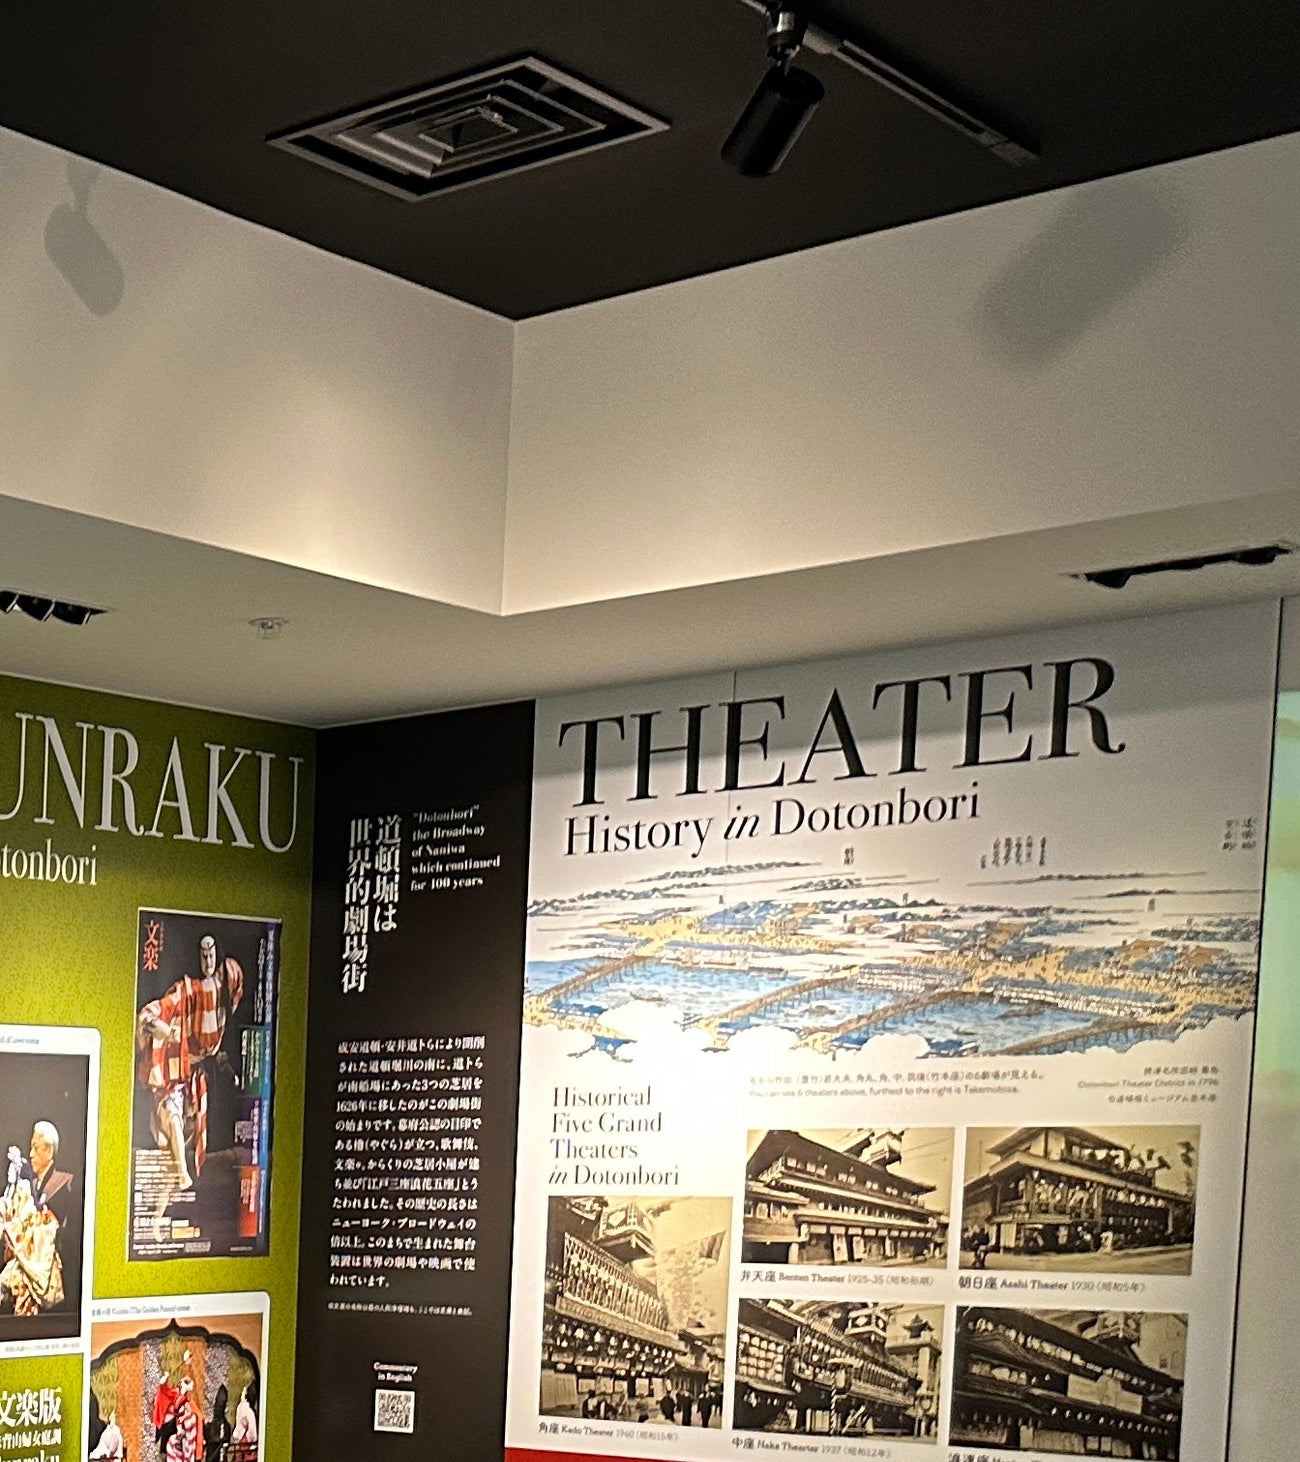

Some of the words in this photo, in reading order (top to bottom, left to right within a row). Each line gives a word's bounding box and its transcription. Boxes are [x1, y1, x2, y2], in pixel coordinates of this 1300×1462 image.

[558, 657, 1127, 807] THEATER
[412, 829, 430, 842] the
[433, 823, 485, 839] Broadway
[564, 812, 714, 862] History
[723, 803, 761, 840] in
[771, 782, 981, 836] Dotonbori
[412, 844, 424, 857] of
[372, 814, 402, 932] 道頓堀は
[412, 861, 443, 874] which
[341, 817, 373, 994] 世界的劇場街
[553, 1085, 651, 1107] Historical
[552, 1113, 593, 1133] Five
[598, 1111, 662, 1133] Grand
[550, 1139, 639, 1159] Theaters
[549, 1165, 568, 1185] in
[574, 1164, 679, 1185] Dotonbori
